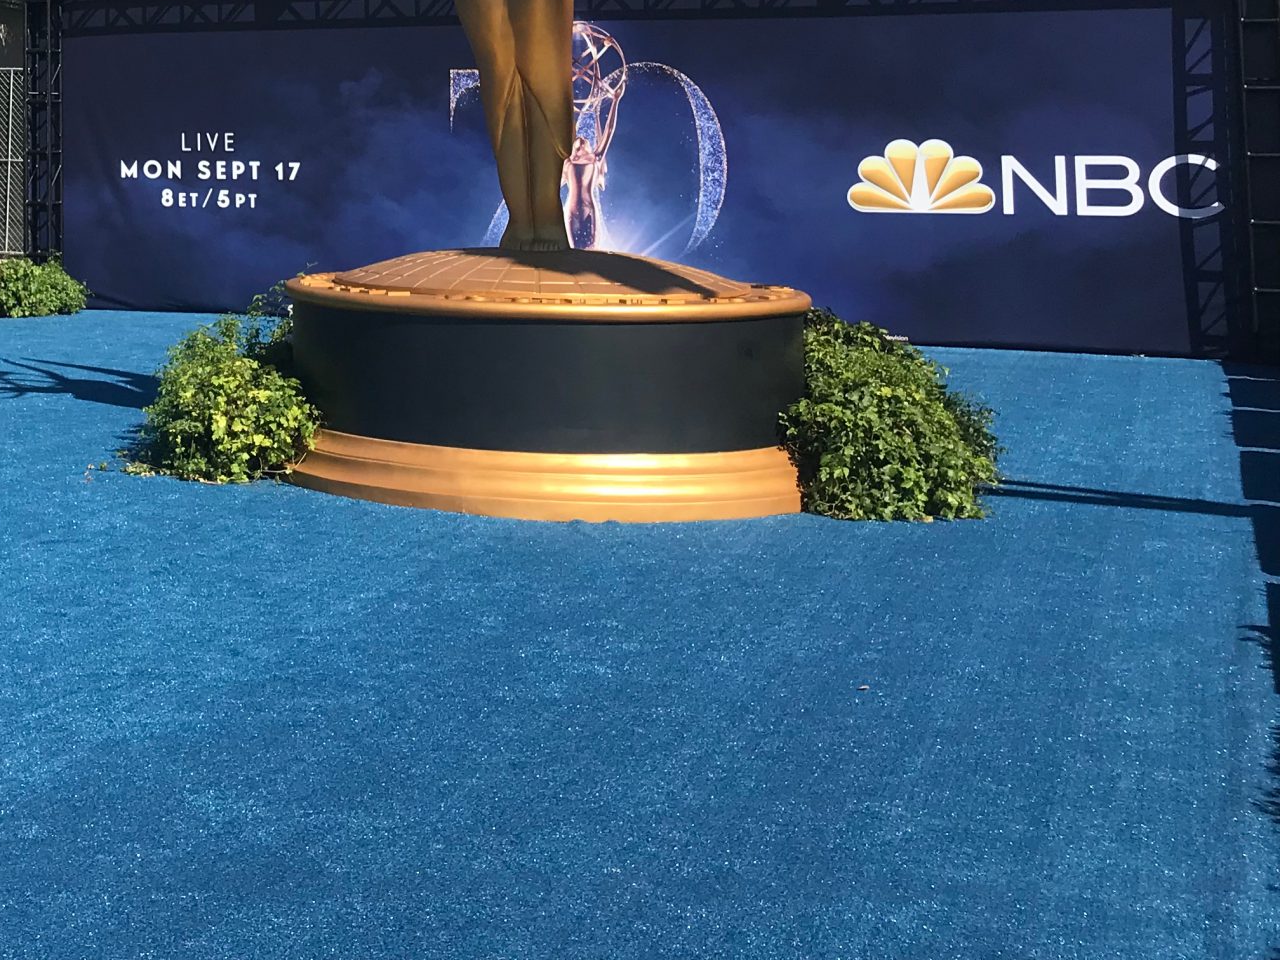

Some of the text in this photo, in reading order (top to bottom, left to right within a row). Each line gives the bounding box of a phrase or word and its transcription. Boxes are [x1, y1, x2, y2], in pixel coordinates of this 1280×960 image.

[181, 132, 235, 152] LIVE
[120, 159, 301, 181] MON SEPT 17
[1000, 153, 1226, 219] NBC
